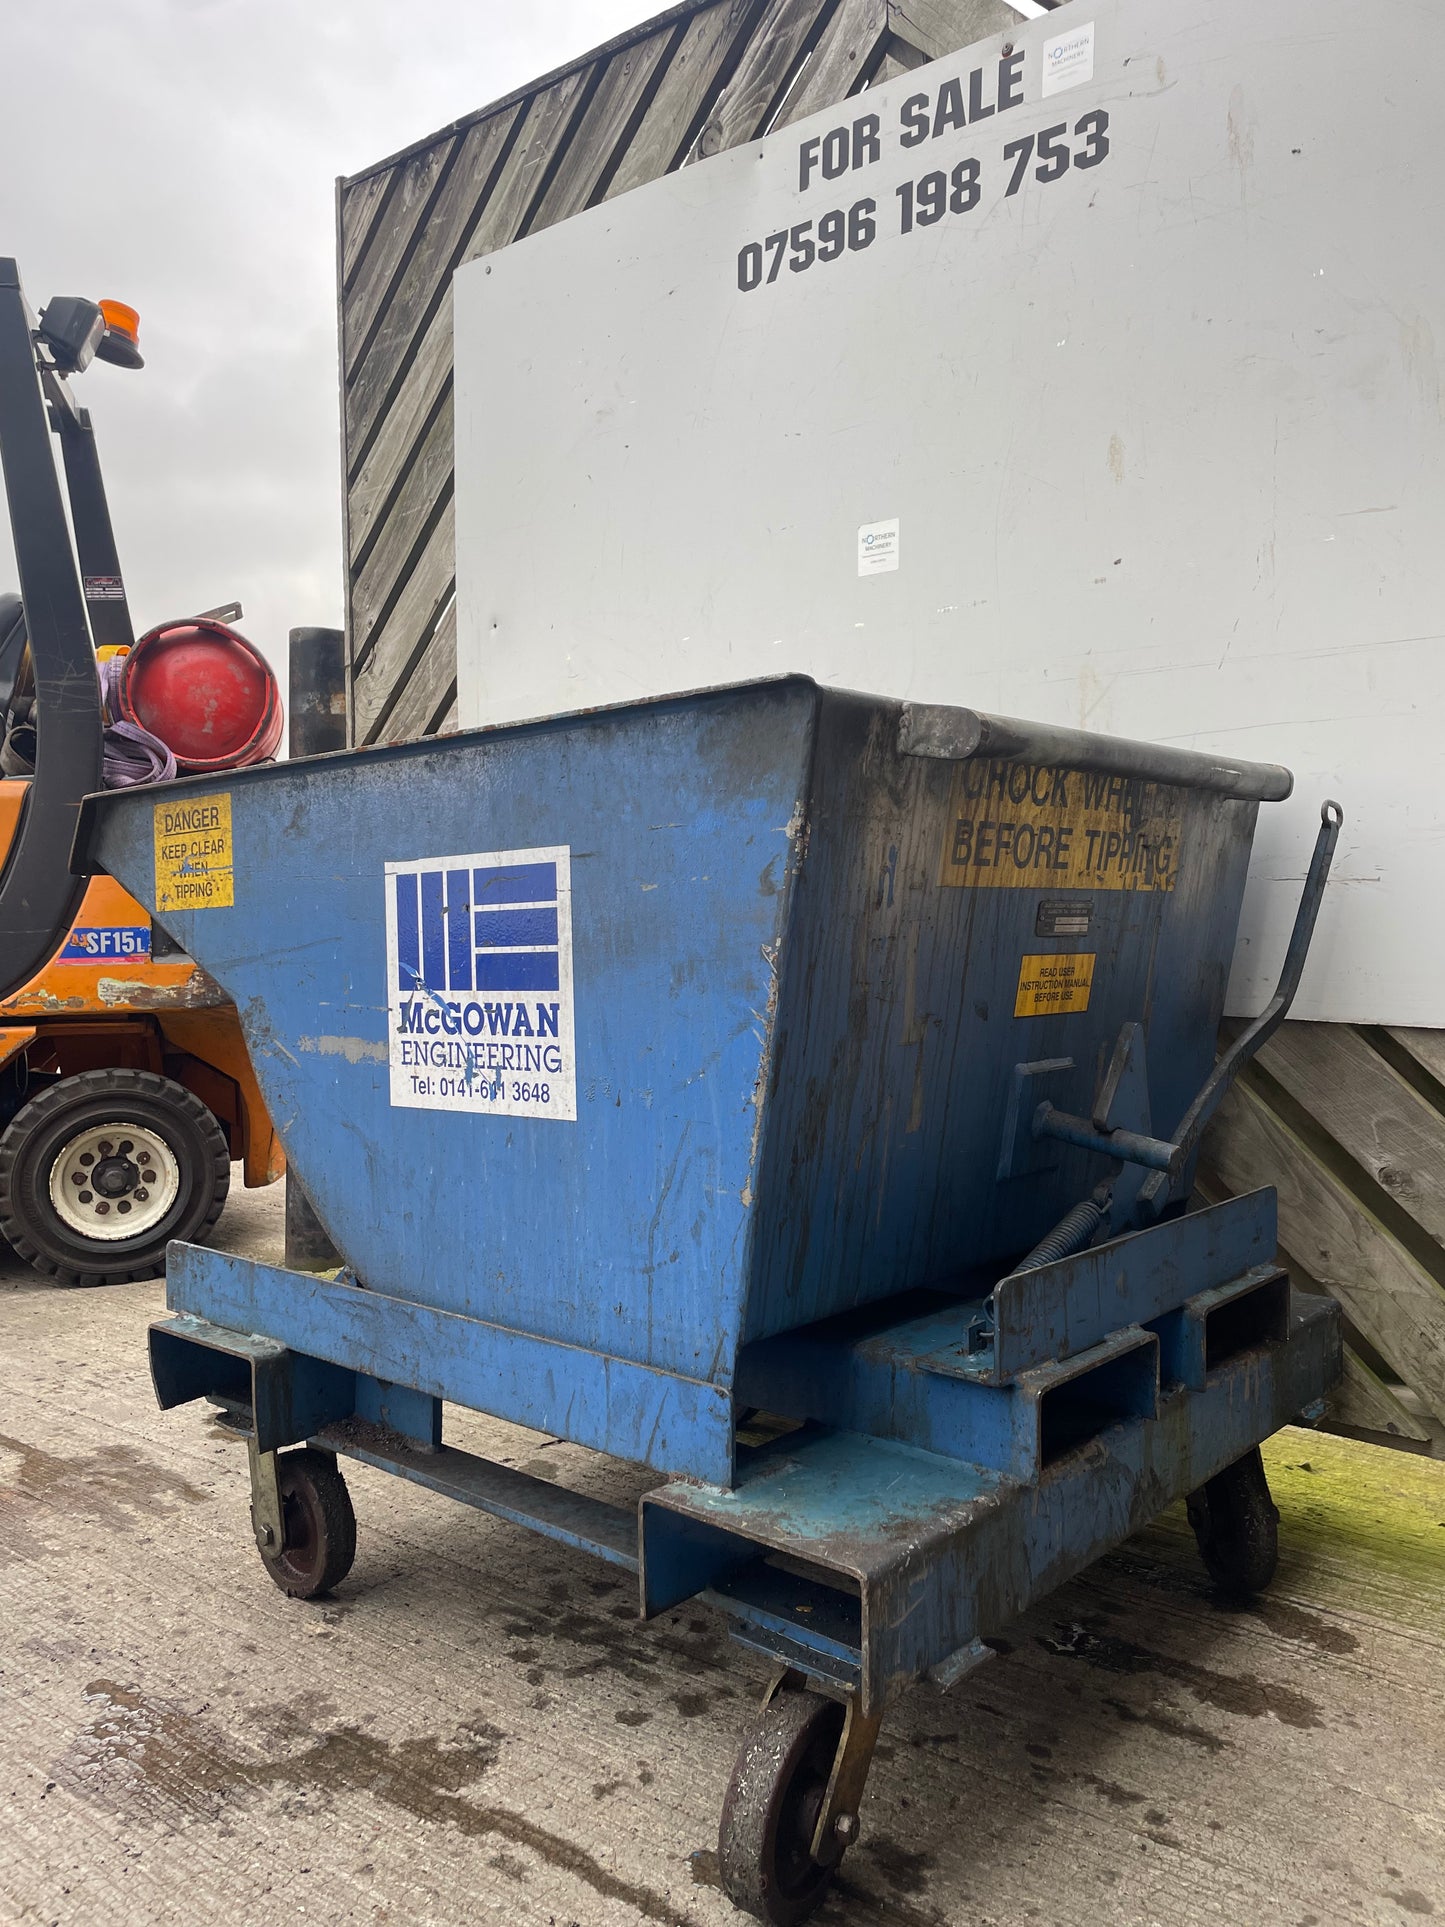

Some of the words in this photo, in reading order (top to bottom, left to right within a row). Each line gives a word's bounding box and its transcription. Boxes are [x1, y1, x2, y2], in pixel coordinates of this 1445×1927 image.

[1047, 36, 1090, 60] NORTHERN
[1051, 50, 1085, 67] MACHINERY
[799, 113, 881, 193] FOR
[900, 50, 1026, 149] SALE
[737, 197, 877, 292] 07596
[895, 157, 981, 235] 198
[1003, 108, 1110, 198] 753
[861, 532, 896, 545] NORTHERN
[864, 542, 892, 552] MACHINERY
[963, 760, 1071, 809] CHOCK
[165, 806, 219, 833] DANGER
[161, 843, 187, 860] KEEP
[190, 838, 225, 857] CLEAR
[951, 818, 1074, 870] BEFORE
[178, 861, 209, 878] WHEN
[174, 881, 213, 899] TIPPING
[85, 931, 146, 954] SF15L
[1040, 967, 1058, 978] READ
[1058, 966, 1075, 977] USER
[1020, 979, 1063, 992] INSTRUCTION
[1064, 978, 1090, 989] MANUAL
[1034, 991, 1060, 1003] BEFORE
[1060, 990, 1074, 1001] USE
[399, 1001, 560, 1038] McGOWAN
[400, 1040, 562, 1073] ENGINEERING
[410, 1075, 435, 1095] Tel:
[512, 1081, 551, 1103] 3648
